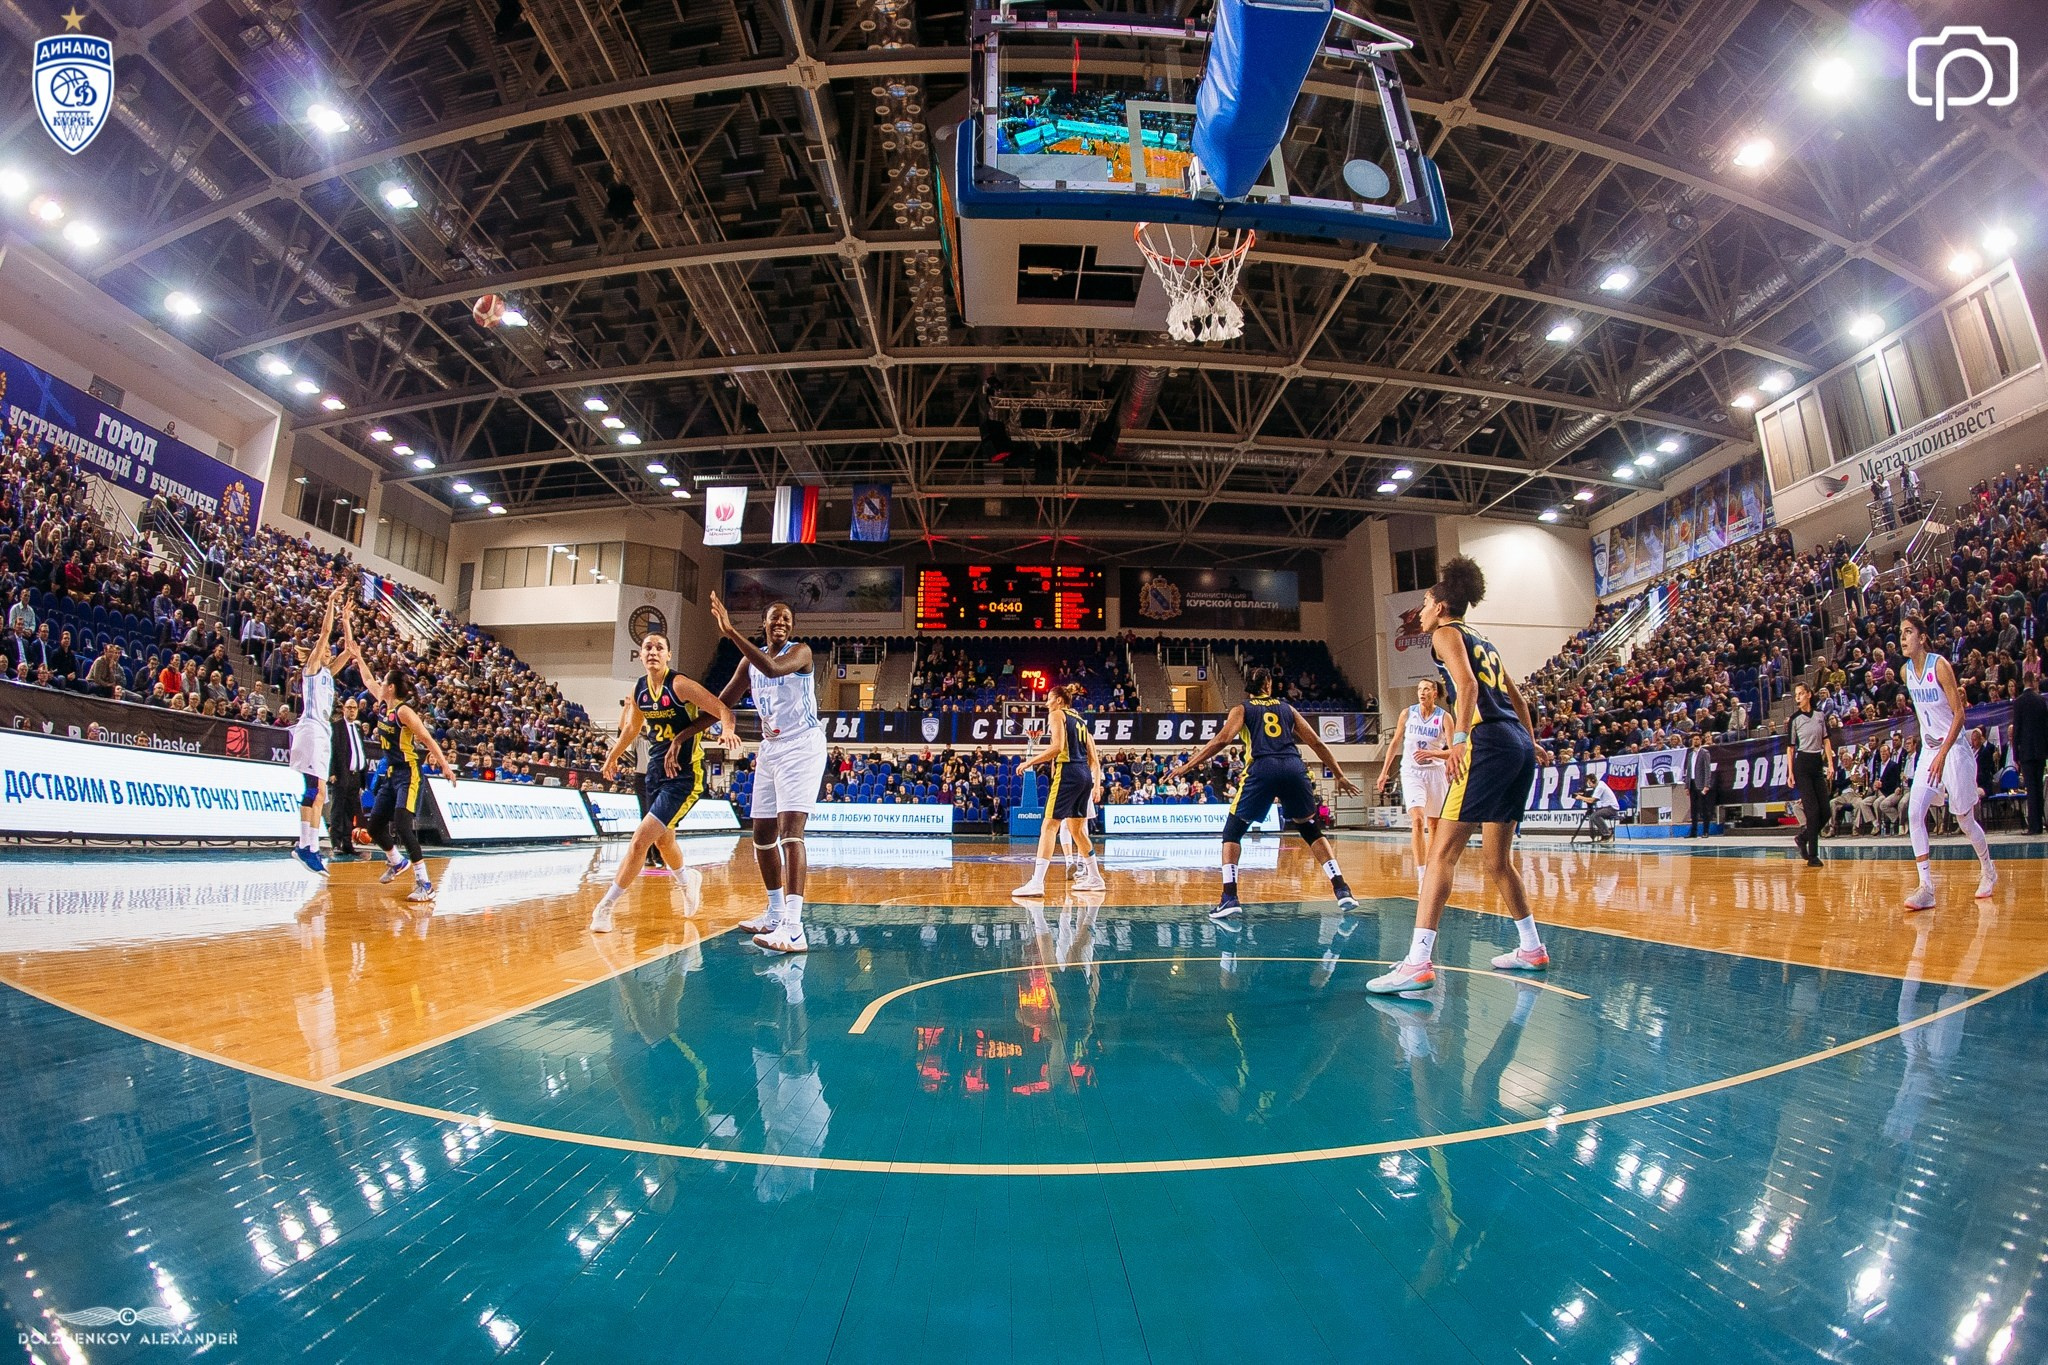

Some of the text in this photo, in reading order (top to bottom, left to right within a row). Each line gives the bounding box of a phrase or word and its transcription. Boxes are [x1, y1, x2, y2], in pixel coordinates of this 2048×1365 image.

[8, 404, 133, 479] УСТРЕМЛЕННЫЙ
[135, 464, 147, 484] В
[95, 412, 158, 466] ГОРОД
[1858, 406, 1995, 483] Металлоинвест
[1185, 592, 1247, 600] АДМИНИСТРАЦИЯ
[1186, 599, 1279, 609] КУРСКОЙ ОБЛАСТИ
[989, 601, 1023, 612] 04:40
[1473, 644, 1508, 693] 32
[760, 696, 773, 716] 31
[1263, 712, 1282, 737] 8
[1924, 710, 1931, 727] 1
[98, 726, 202, 754] @russbasket
[654, 724, 675, 742] 24
[1409, 724, 1439, 738] DYNAMO
[1609, 763, 1638, 777] КУРСК
[5, 769, 109, 804] ДОСТАВИМ
[109, 779, 124, 805] В
[126, 781, 191, 809] ЛЮБУЮ
[190, 786, 239, 811] ТОЧКУ
[448, 802, 497, 821] ДОСТАВИМ
[831, 813, 837, 822] В
[838, 813, 872, 823] ЛЮБУЮ
[873, 814, 900, 823] ТОЧКУ
[902, 814, 944, 824] ПЛАНЕТЫ
[1113, 815, 1161, 825] ДОСТАВИМ
[1162, 815, 1168, 823] В
[1169, 815, 1202, 824] ЛЮБУЮ
